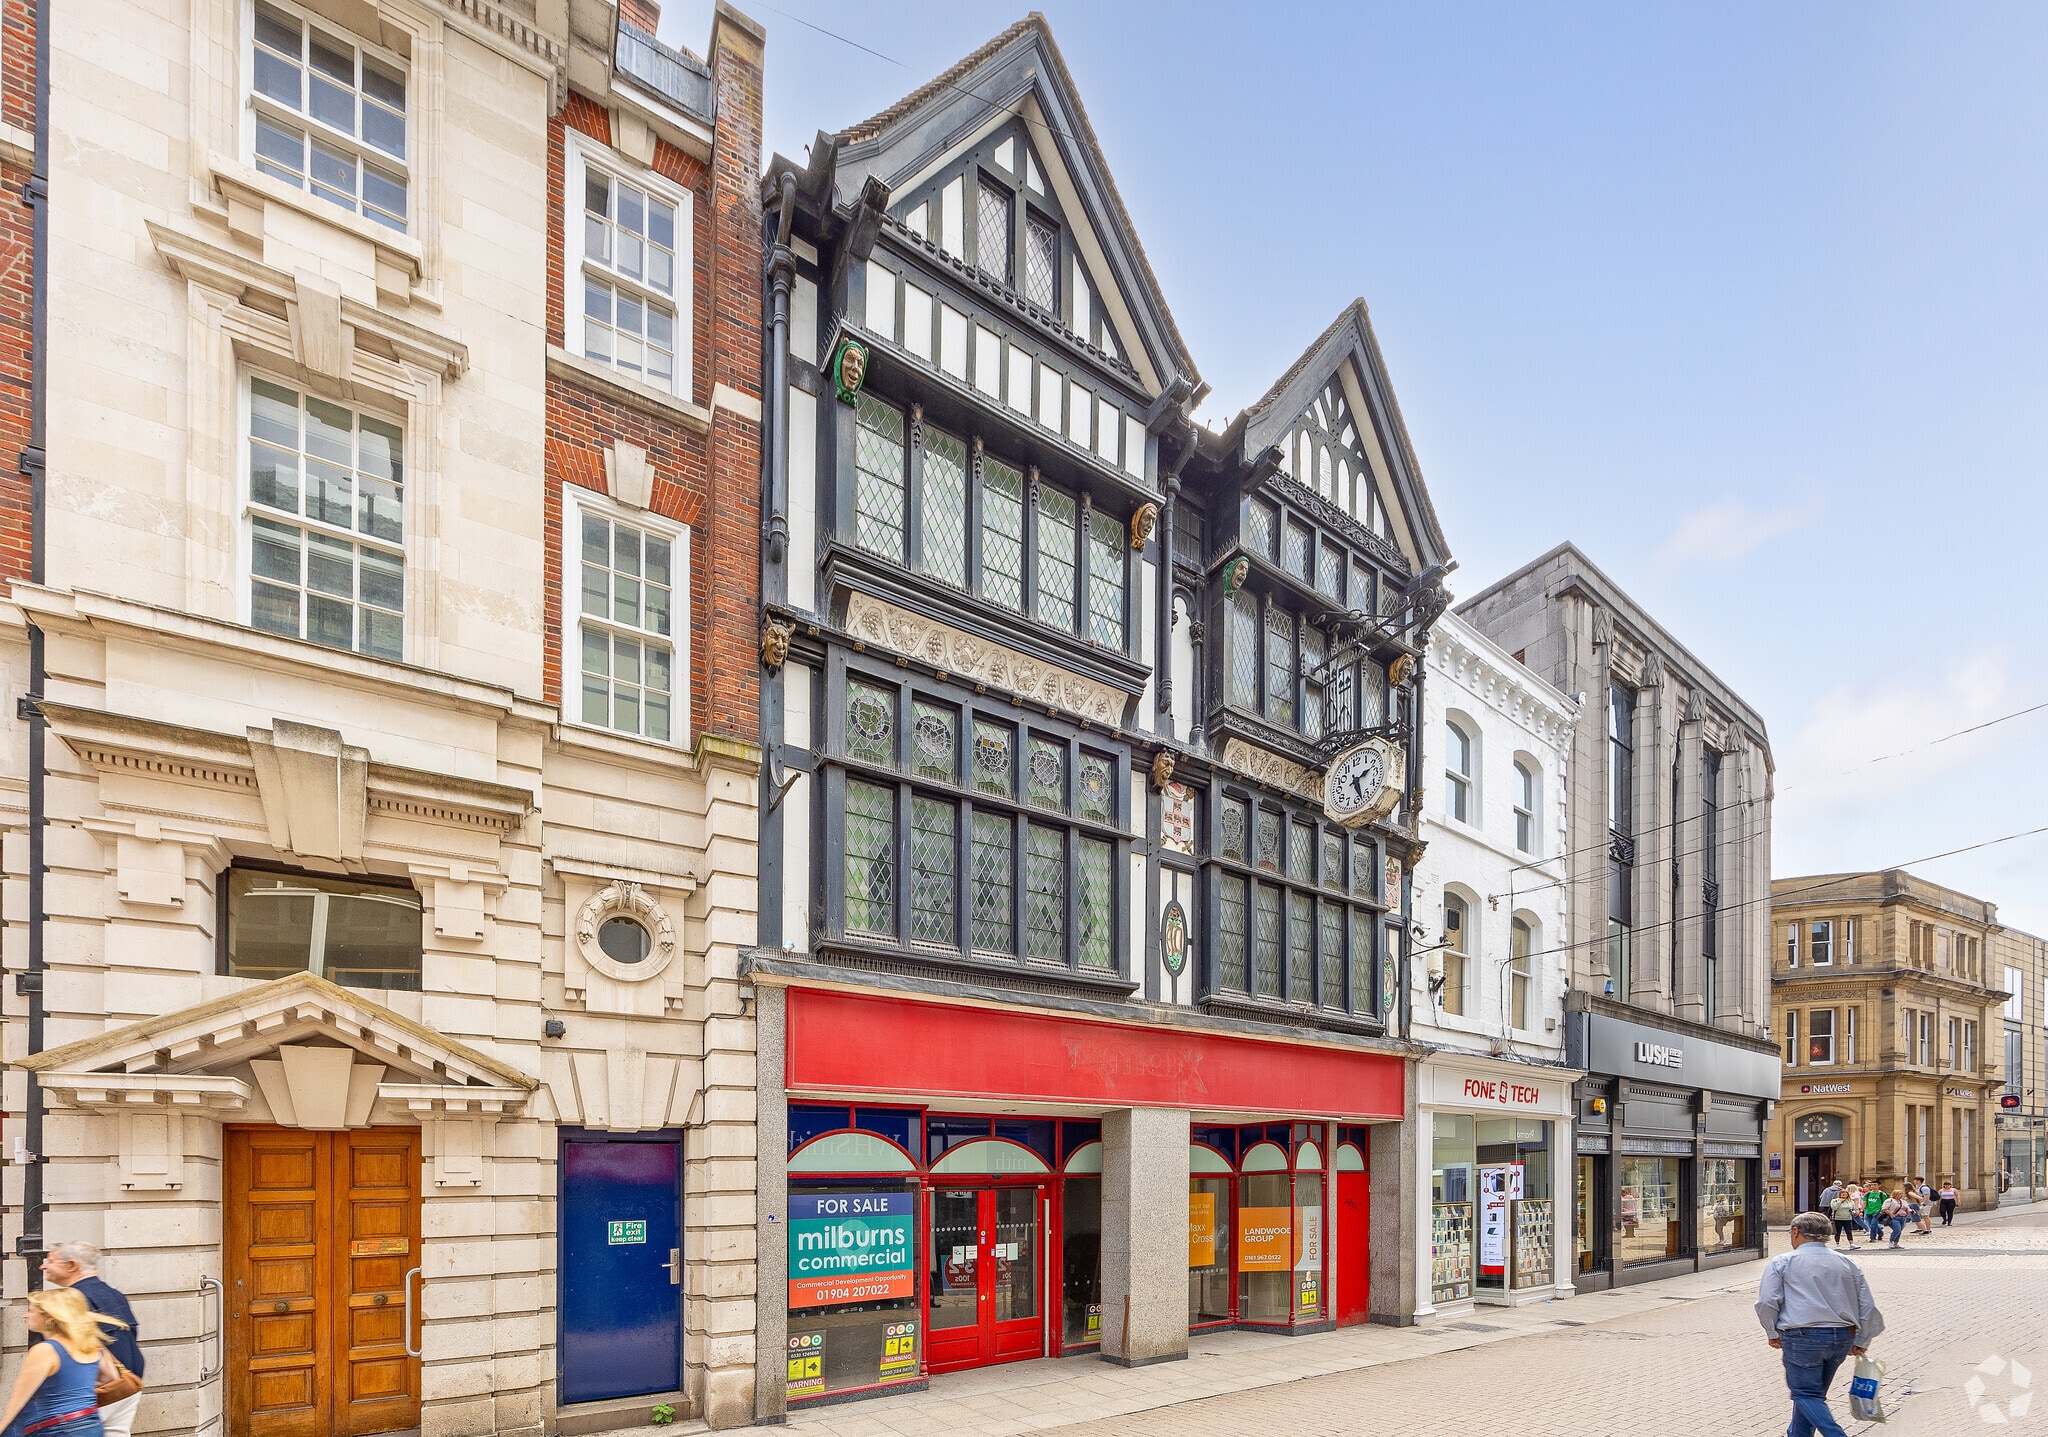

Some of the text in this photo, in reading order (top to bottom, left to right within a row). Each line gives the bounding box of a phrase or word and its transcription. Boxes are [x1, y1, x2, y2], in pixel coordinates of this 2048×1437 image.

[1352, 757, 1361, 767] 12
[1345, 765, 1350, 774] 11
[1373, 767, 1379, 777] 3
[1338, 775, 1347, 785] 10
[1370, 778, 1376, 786] 4
[1336, 786, 1342, 794] 9
[1363, 788, 1370, 798] 5
[1339, 794, 1345, 802] 8
[1346, 797, 1351, 806] 7
[1354, 796, 1360, 804] 6
[1637, 1042, 1669, 1066] LUSH
[1464, 1079, 1539, 1104] FONE TECH
[1813, 1084, 1850, 1093] NatWest
[817, 1198, 888, 1214] FOR SALE
[798, 1225, 905, 1250] milburns
[1192, 1234, 1214, 1243] Cross
[1244, 1235, 1274, 1243] GROUP
[1309, 1216, 1317, 1260] FOR SALE
[798, 1248, 905, 1271] commercial
[796, 1274, 907, 1289] Commercial Development Opportunity
[817, 1284, 889, 1301] 01904 207022
[885, 1355, 912, 1363] WARNING
[786, 1378, 822, 1390] WARNING
